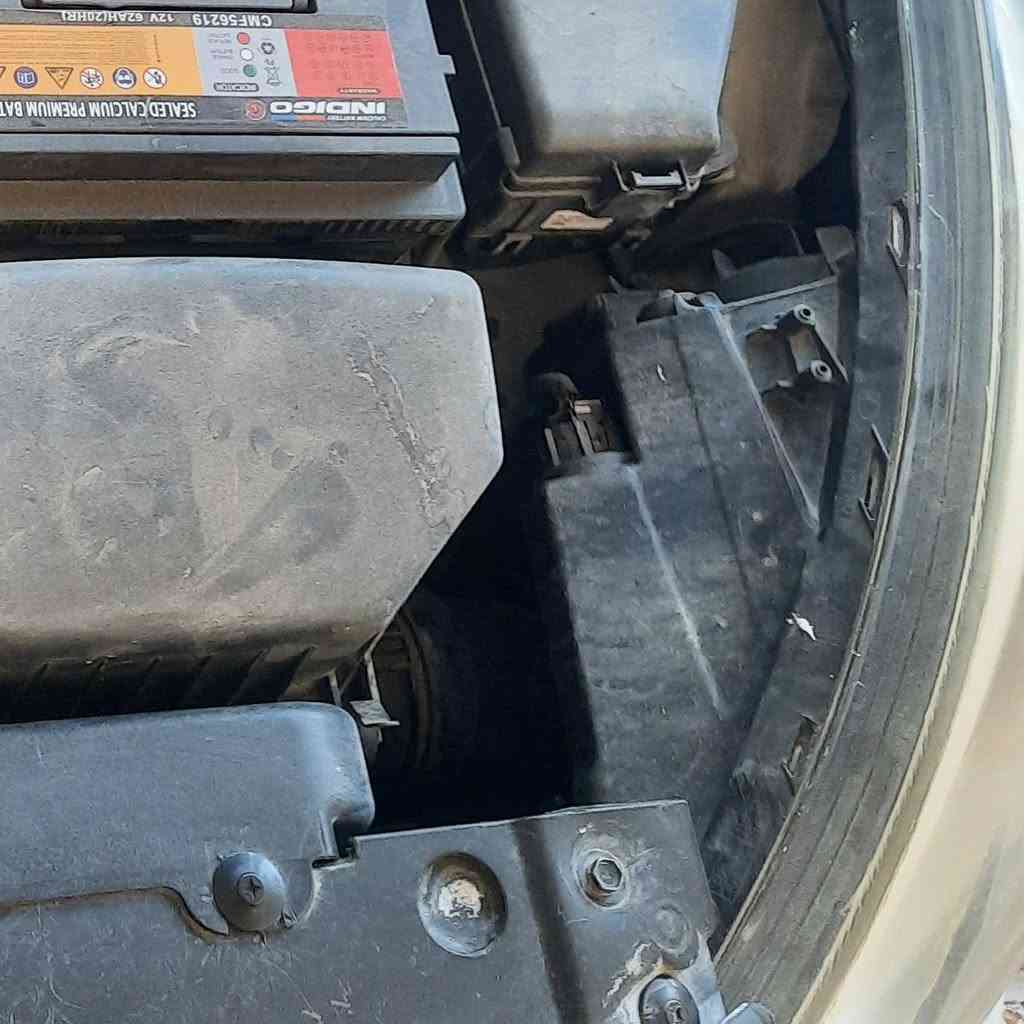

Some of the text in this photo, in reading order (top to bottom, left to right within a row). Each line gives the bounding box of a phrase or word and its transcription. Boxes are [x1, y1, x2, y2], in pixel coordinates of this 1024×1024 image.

[150, 12, 176, 23] 12V
[192, 12, 273, 27] CMF56219
[25, 101, 86, 116] PREMIUM
[87, 101, 146, 117] CALCIUM
[149, 101, 197, 118] SEALED
[269, 101, 386, 114] INDIGO
